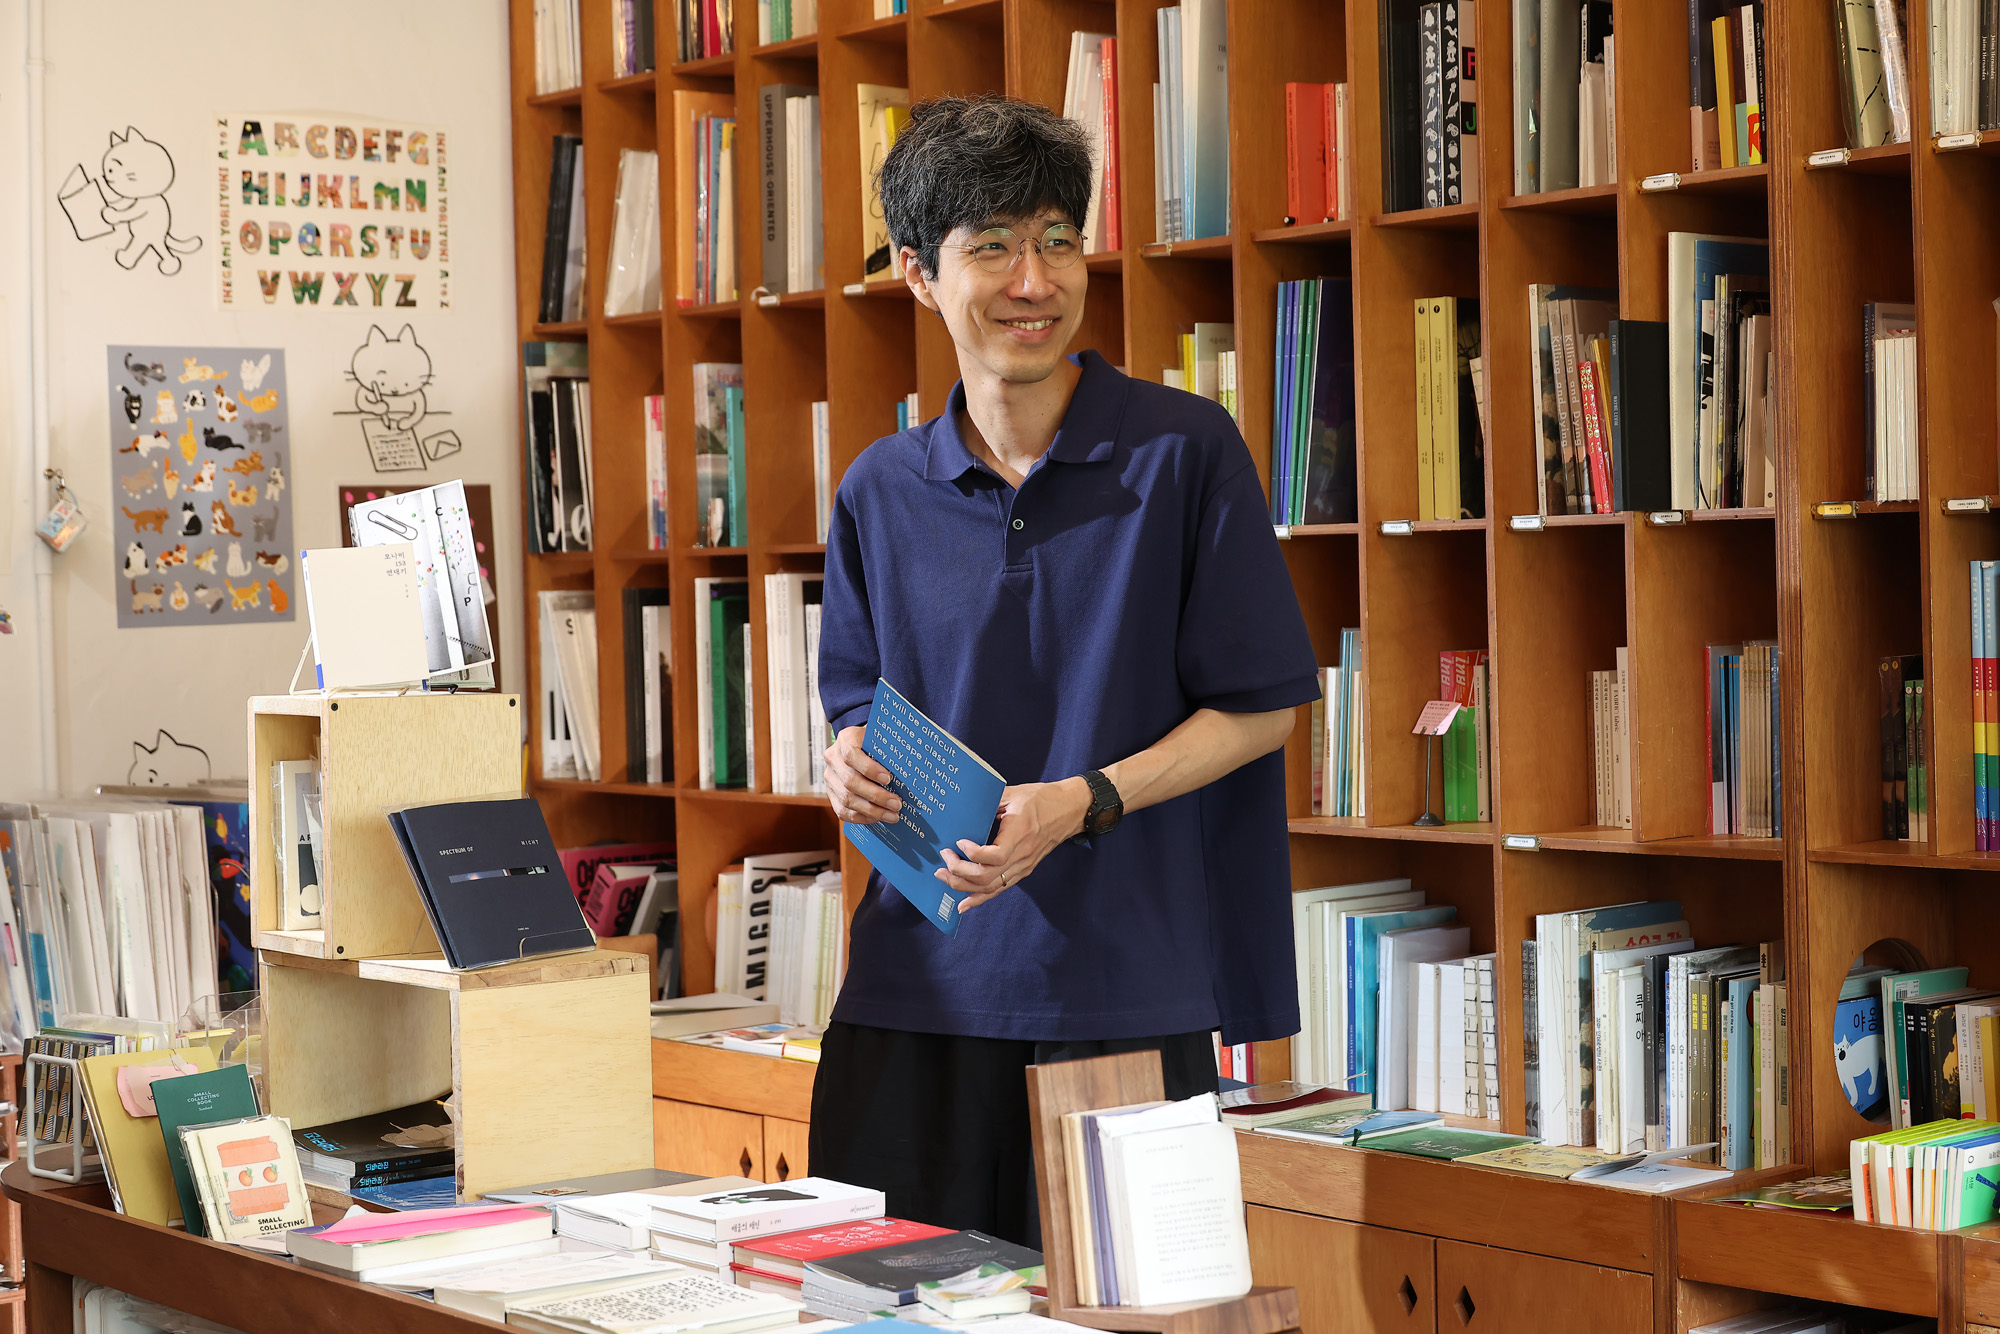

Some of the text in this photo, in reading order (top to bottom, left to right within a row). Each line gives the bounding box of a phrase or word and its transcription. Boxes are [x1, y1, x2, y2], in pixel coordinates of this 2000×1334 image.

[1551, 334, 1569, 449] Killing and Dying
[1564, 333, 1583, 447] Killing and Dying
[880, 703, 959, 776] to name a class of
[892, 697, 907, 715] will
[908, 711, 920, 727] be
[921, 725, 957, 758] difficult
[873, 728, 888, 746] the
[889, 743, 904, 761] sky
[905, 756, 913, 767] is
[914, 765, 930, 782] not
[931, 779, 947, 797] the
[876, 715, 923, 761] Landscape
[924, 756, 934, 771] in
[935, 767, 961, 793] which
[928, 793, 947, 812] and
[439, 846, 467, 856] SPECTRUM
[187, 1092, 220, 1103] COLLECTING
[194, 1090, 211, 1099] SMALL
[257, 1216, 282, 1225] SMALL
[259, 1219, 306, 1232] COLLECTING
